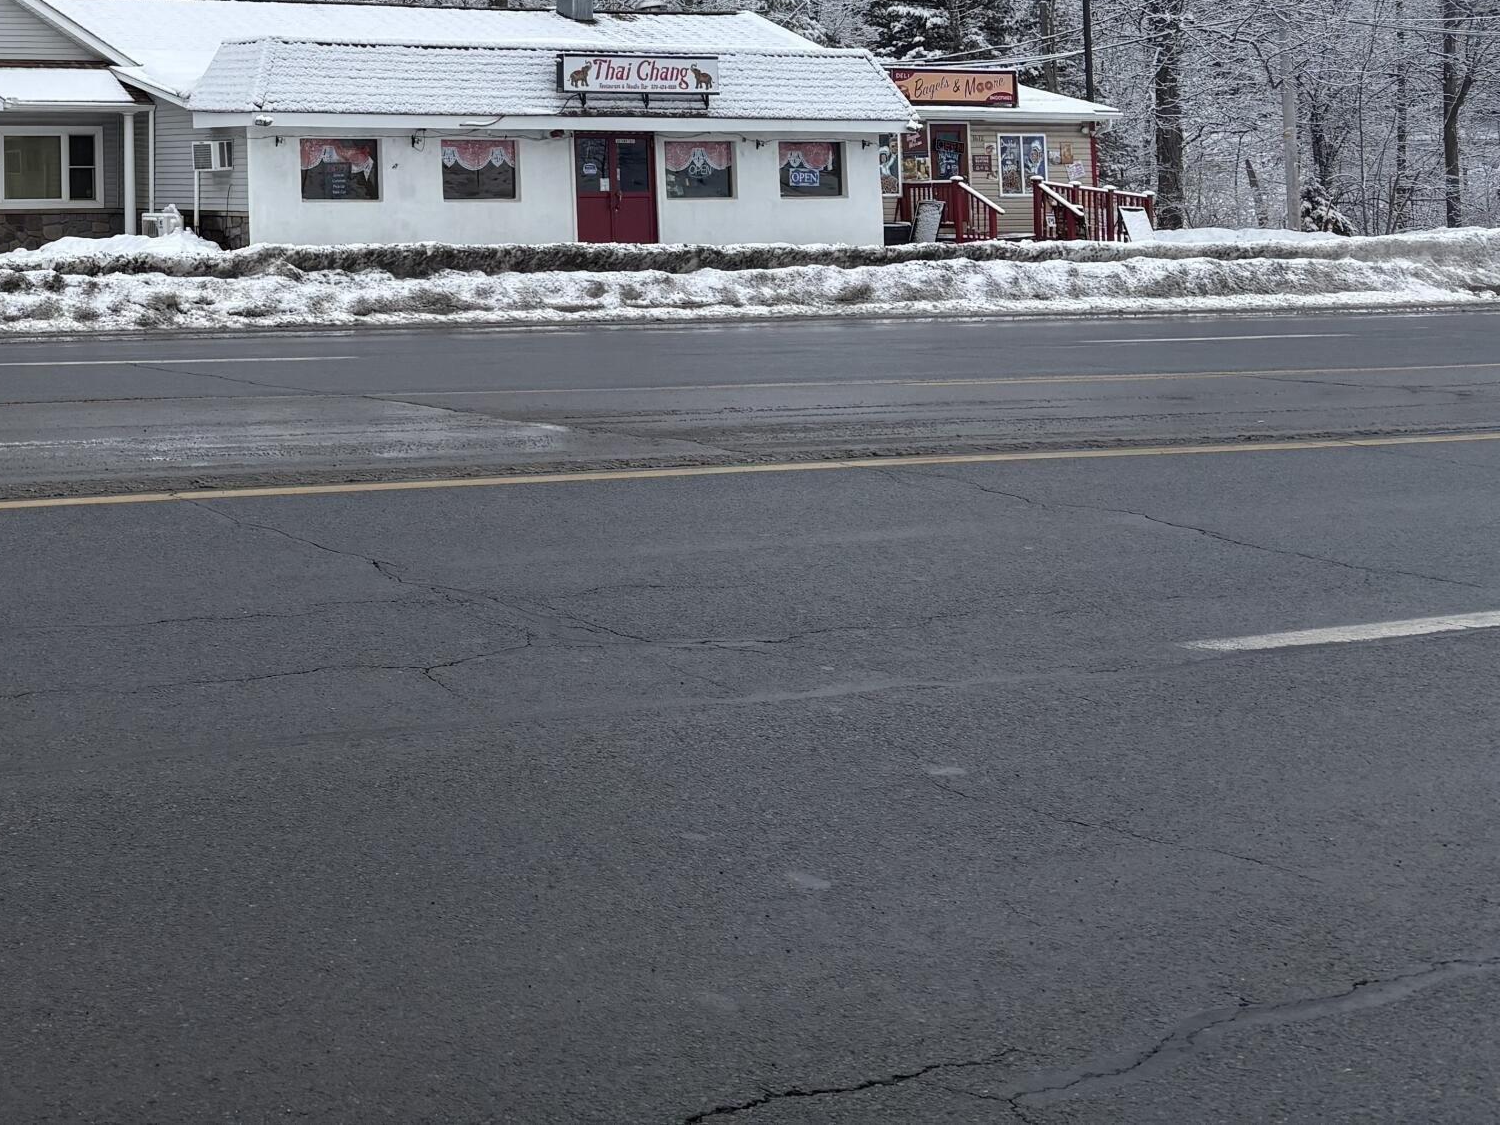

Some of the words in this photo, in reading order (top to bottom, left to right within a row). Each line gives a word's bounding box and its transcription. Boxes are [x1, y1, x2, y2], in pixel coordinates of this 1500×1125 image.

[592, 59, 632, 81] Thai
[636, 59, 690, 90] Chang
[914, 76, 949, 98] Bagels
[952, 77, 960, 93] &
[688, 164, 712, 175] OPEN
[791, 172, 818, 183] OPEN
